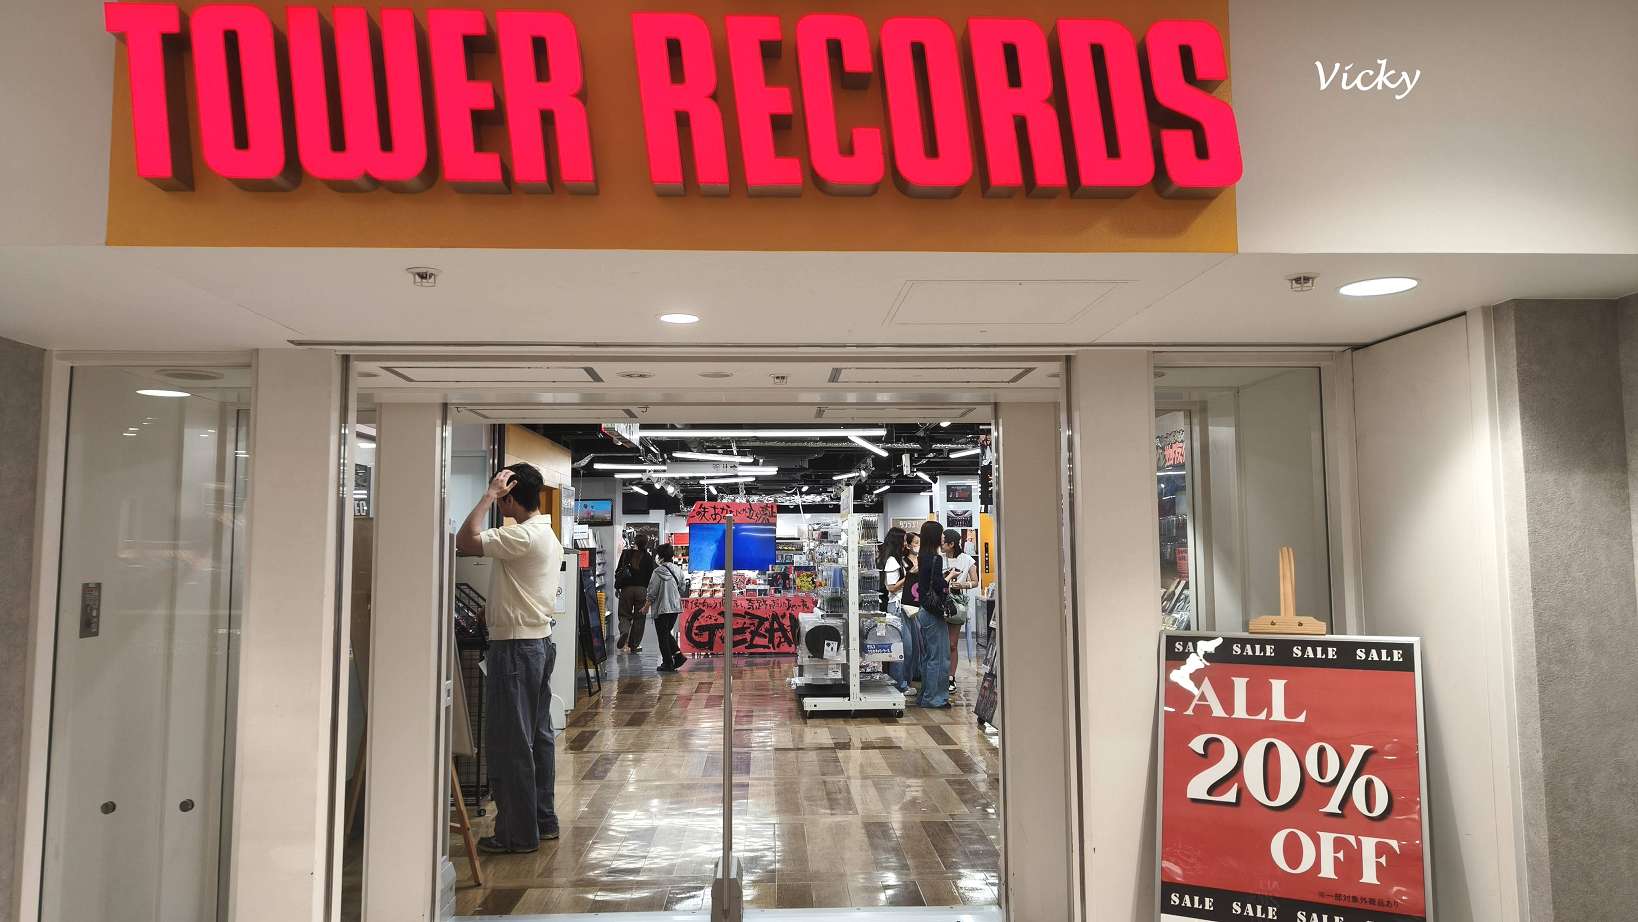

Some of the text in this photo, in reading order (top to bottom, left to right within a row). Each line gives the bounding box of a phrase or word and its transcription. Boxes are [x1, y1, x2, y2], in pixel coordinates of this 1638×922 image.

[104, 2, 1243, 194] TOWER RECORDS
[1174, 641, 1404, 662] SA SALE SALE SALE
[1184, 676, 1307, 722] ALL
[1186, 733, 1390, 818] 20%
[1270, 828, 1401, 885] OFF
[1170, 893, 1215, 911] SALE
[1232, 901, 1278, 920] SALE
